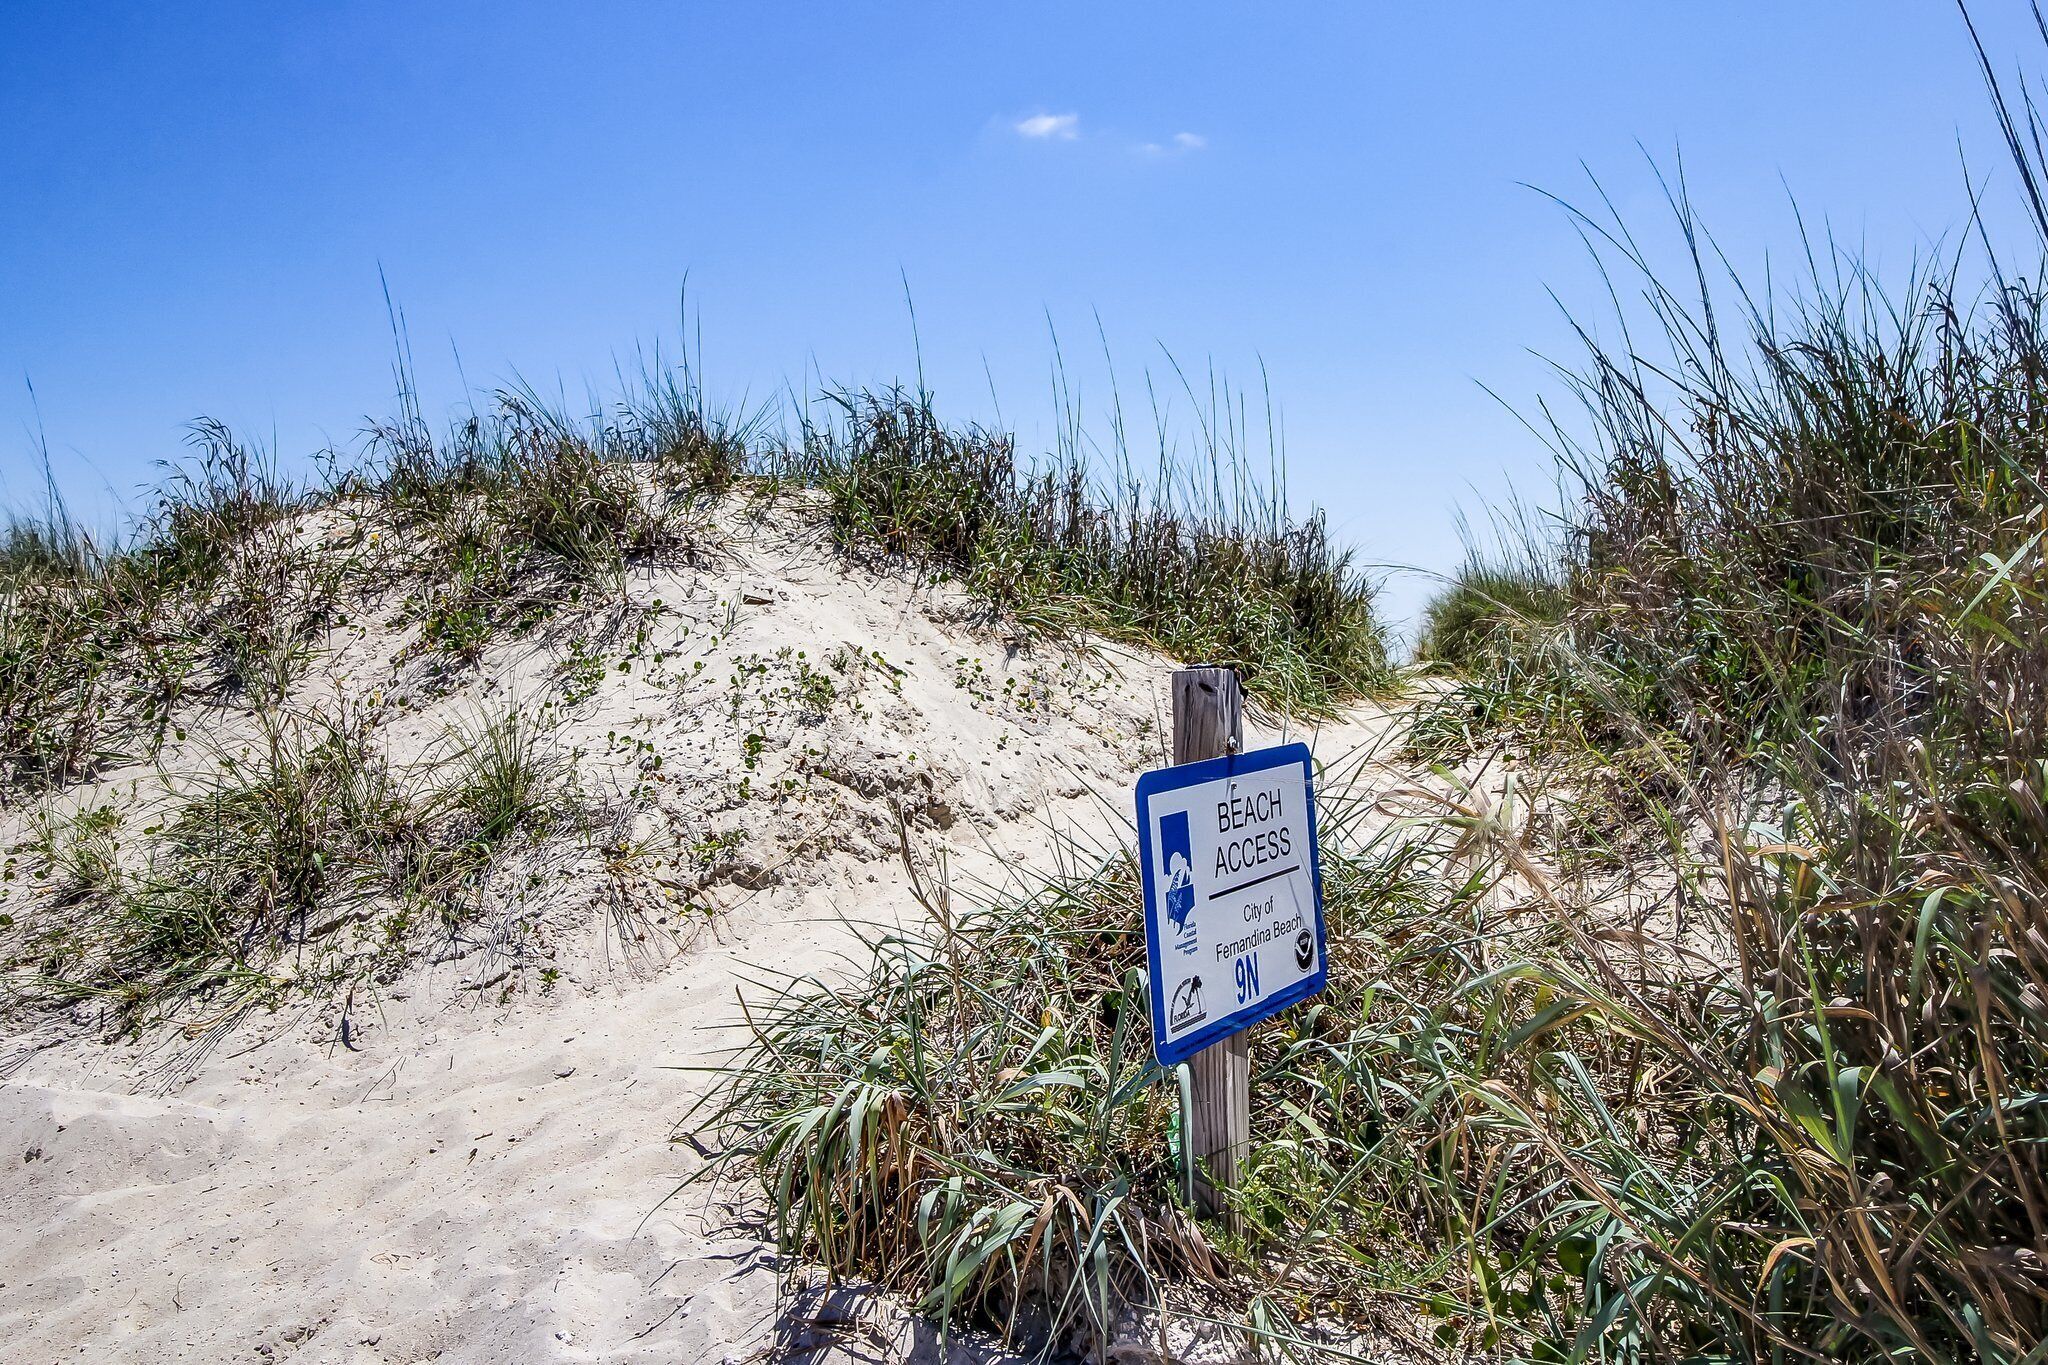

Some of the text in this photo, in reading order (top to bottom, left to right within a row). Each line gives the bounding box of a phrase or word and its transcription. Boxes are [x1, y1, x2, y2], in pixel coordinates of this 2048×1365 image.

[1217, 788, 1282, 834] BEACH
[1215, 827, 1291, 878] ACCESS
[1243, 895, 1274, 922] City of
[1216, 913, 1301, 962] Fernandina Beach
[1235, 951, 1260, 1004] 9N
